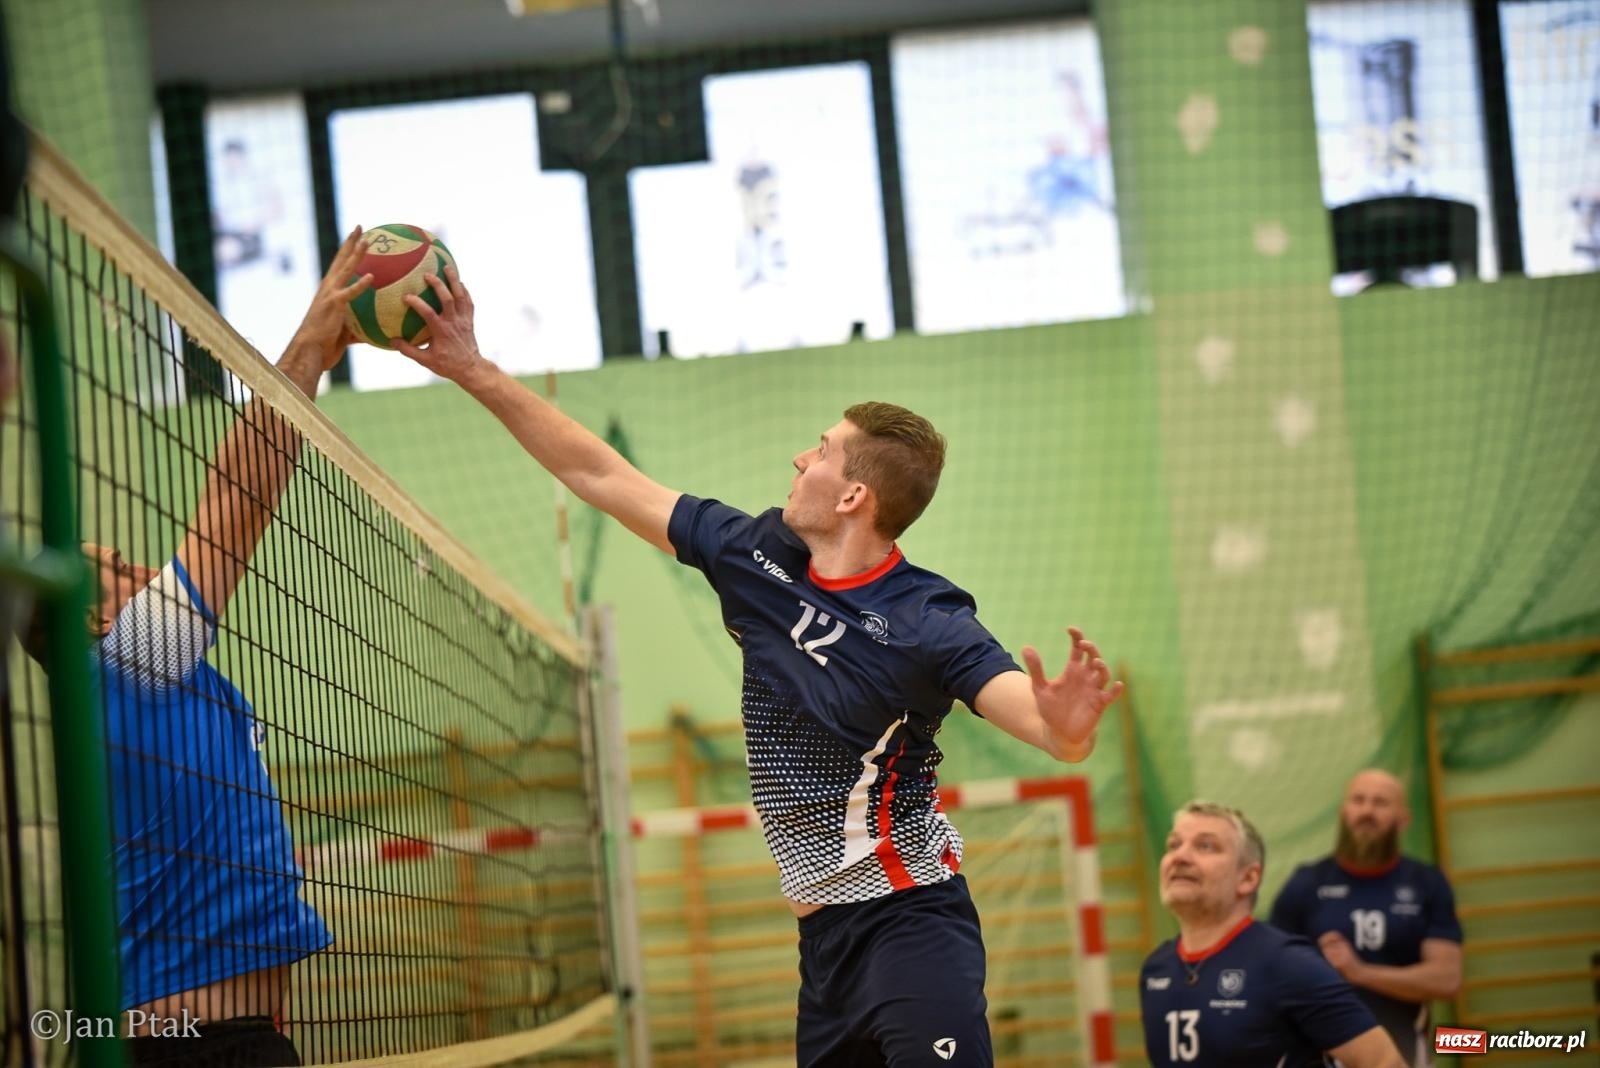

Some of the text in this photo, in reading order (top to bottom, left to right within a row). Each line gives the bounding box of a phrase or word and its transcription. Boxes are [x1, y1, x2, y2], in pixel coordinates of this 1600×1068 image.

[367, 234, 398, 254] PS
[790, 600, 847, 667] 12
[1351, 908, 1386, 951] 19
[1165, 1009, 1200, 1062] 13
